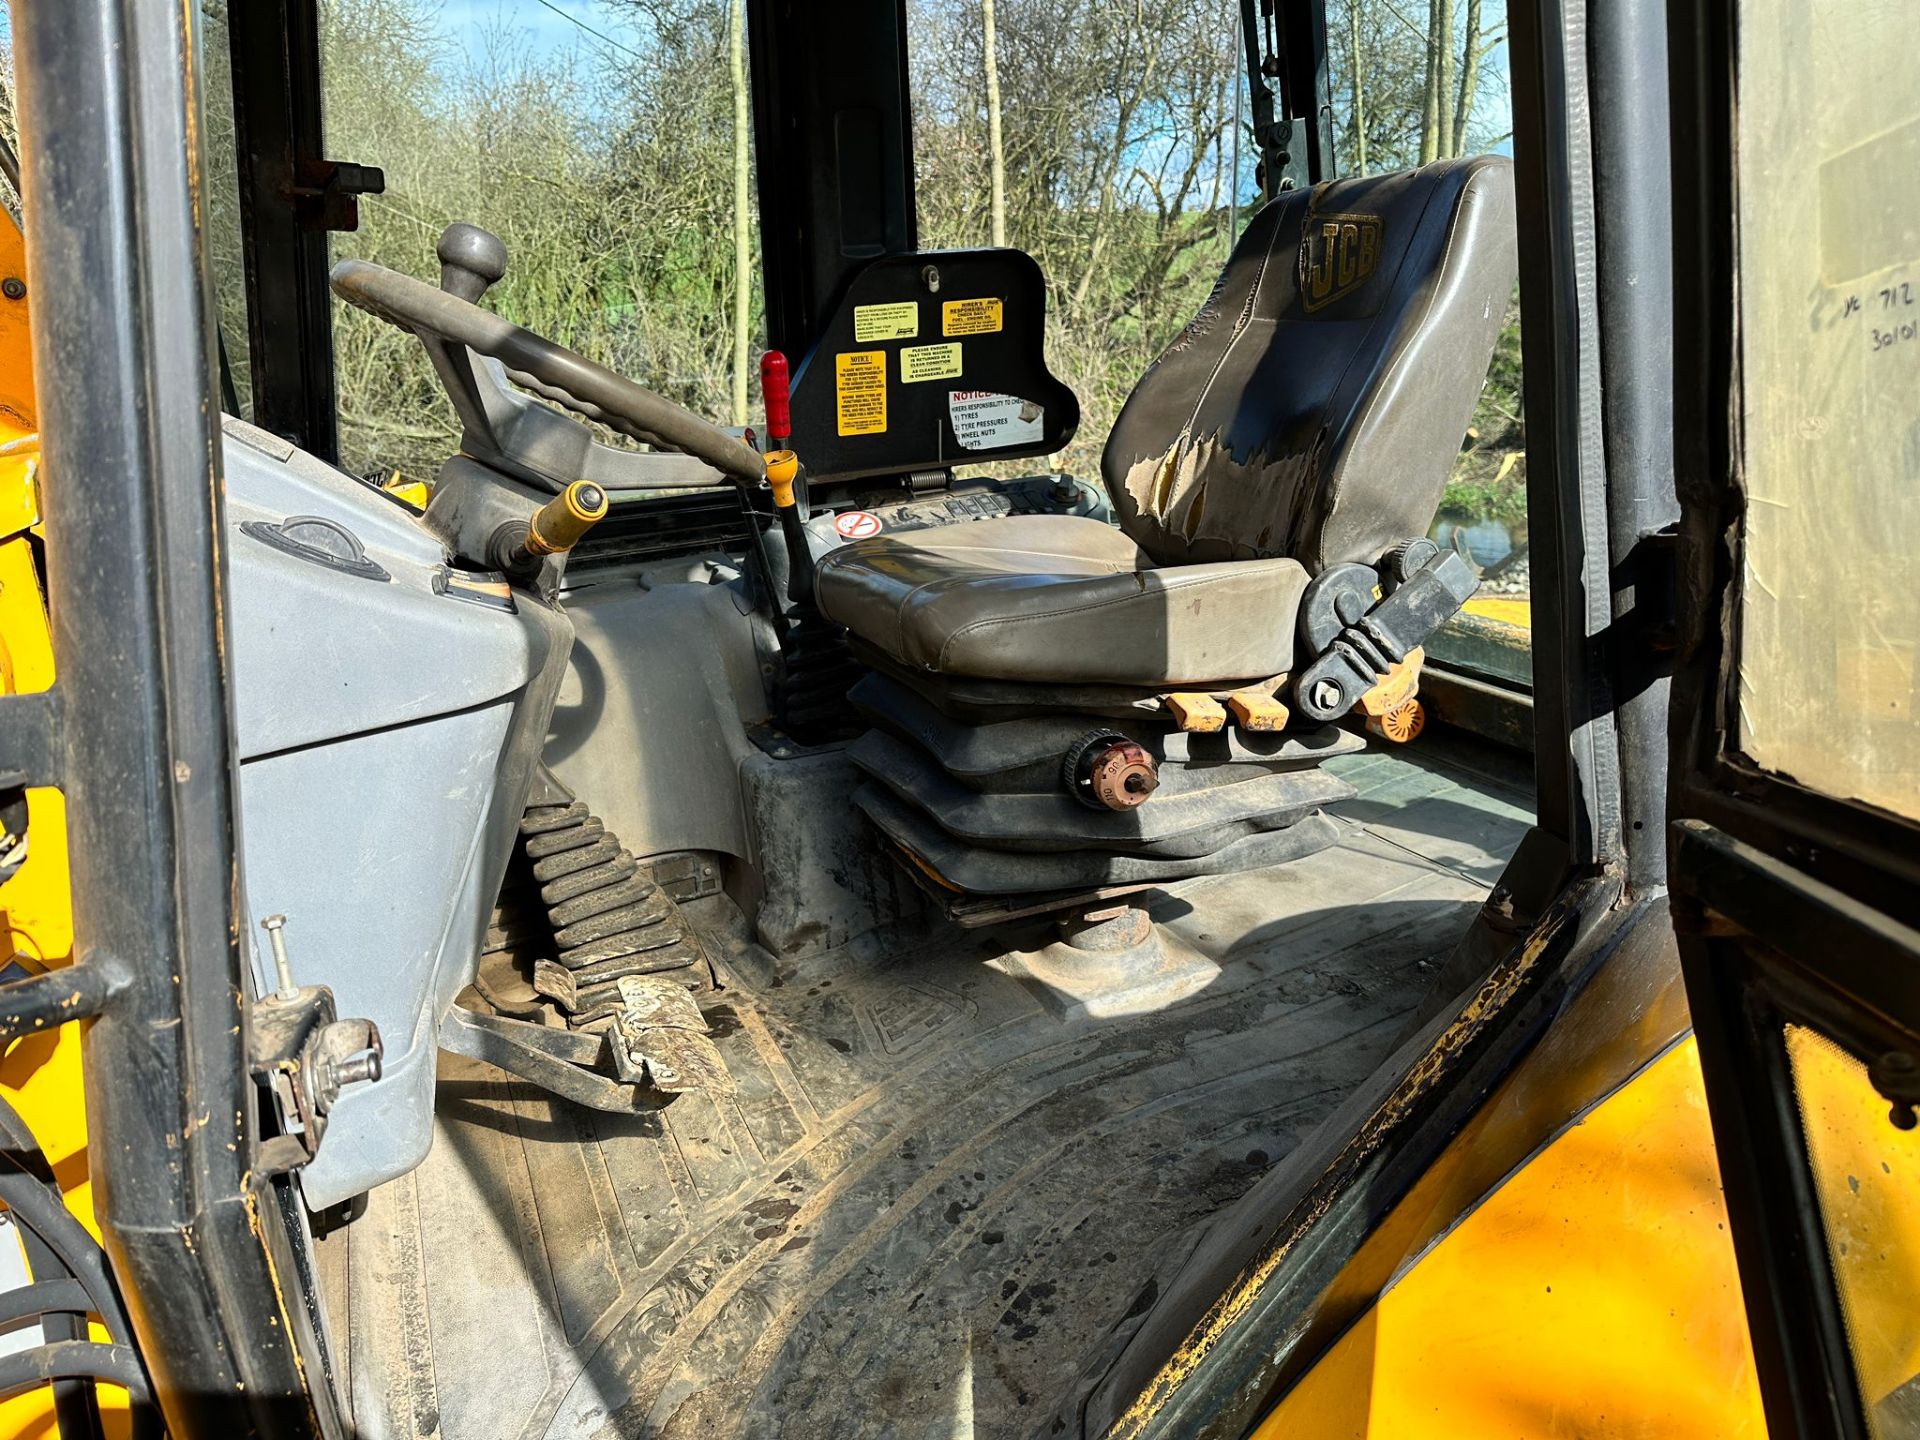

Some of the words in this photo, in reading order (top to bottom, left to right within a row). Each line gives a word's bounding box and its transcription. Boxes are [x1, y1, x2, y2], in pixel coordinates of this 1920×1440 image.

[1312, 224, 1376, 298] JCB
[953, 391, 991, 400] NOTICE
[968, 400, 1004, 411] RESPONSIBILITY
[961, 412, 978, 421] TYRES
[961, 422, 976, 431] TYRE
[976, 418, 1008, 428] PRESSURES
[961, 431, 980, 439] WHEEL
